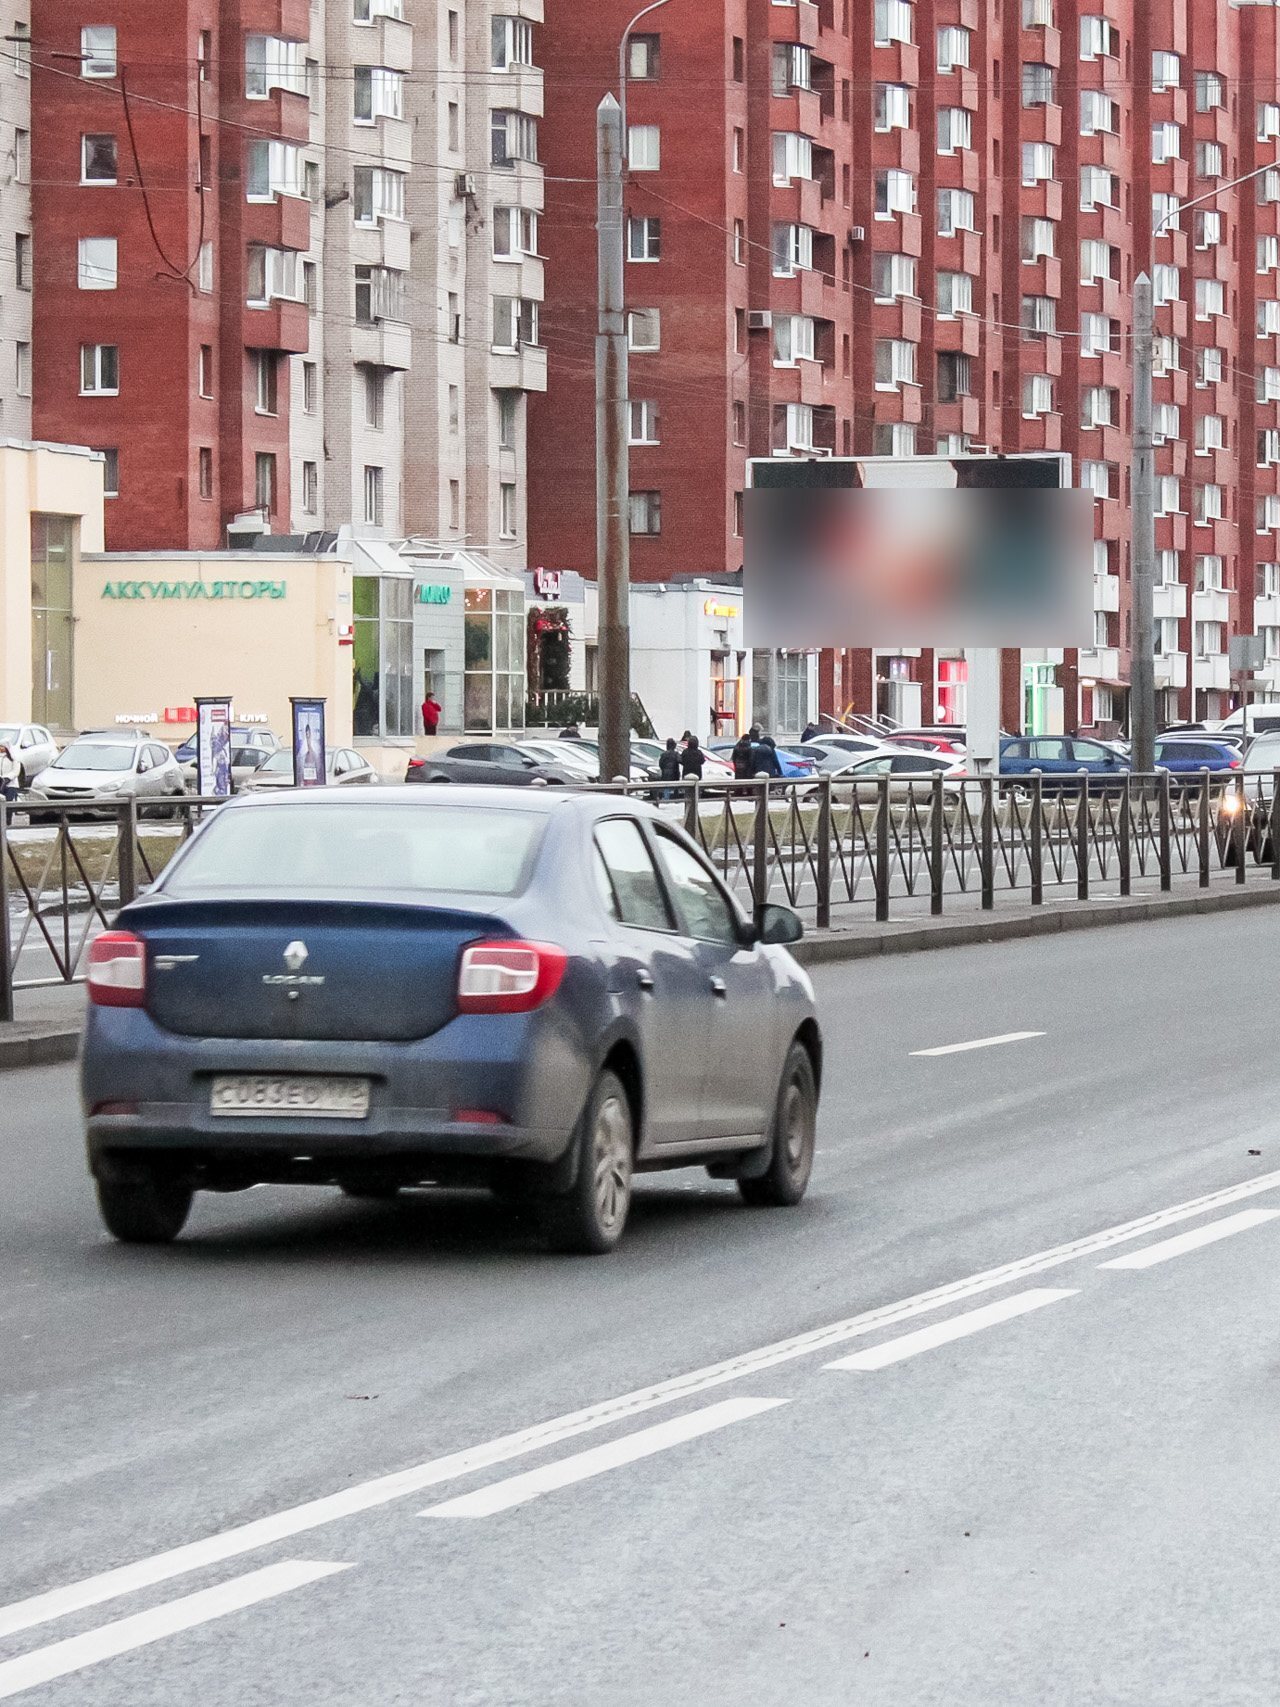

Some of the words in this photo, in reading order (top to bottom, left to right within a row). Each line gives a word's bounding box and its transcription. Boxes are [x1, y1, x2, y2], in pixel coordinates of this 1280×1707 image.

[101, 580, 286, 599] АККУМУЛЯТОРЫ
[115, 712, 158, 723] НОЧНОЙ
[239, 711, 268, 722] КЛУБ
